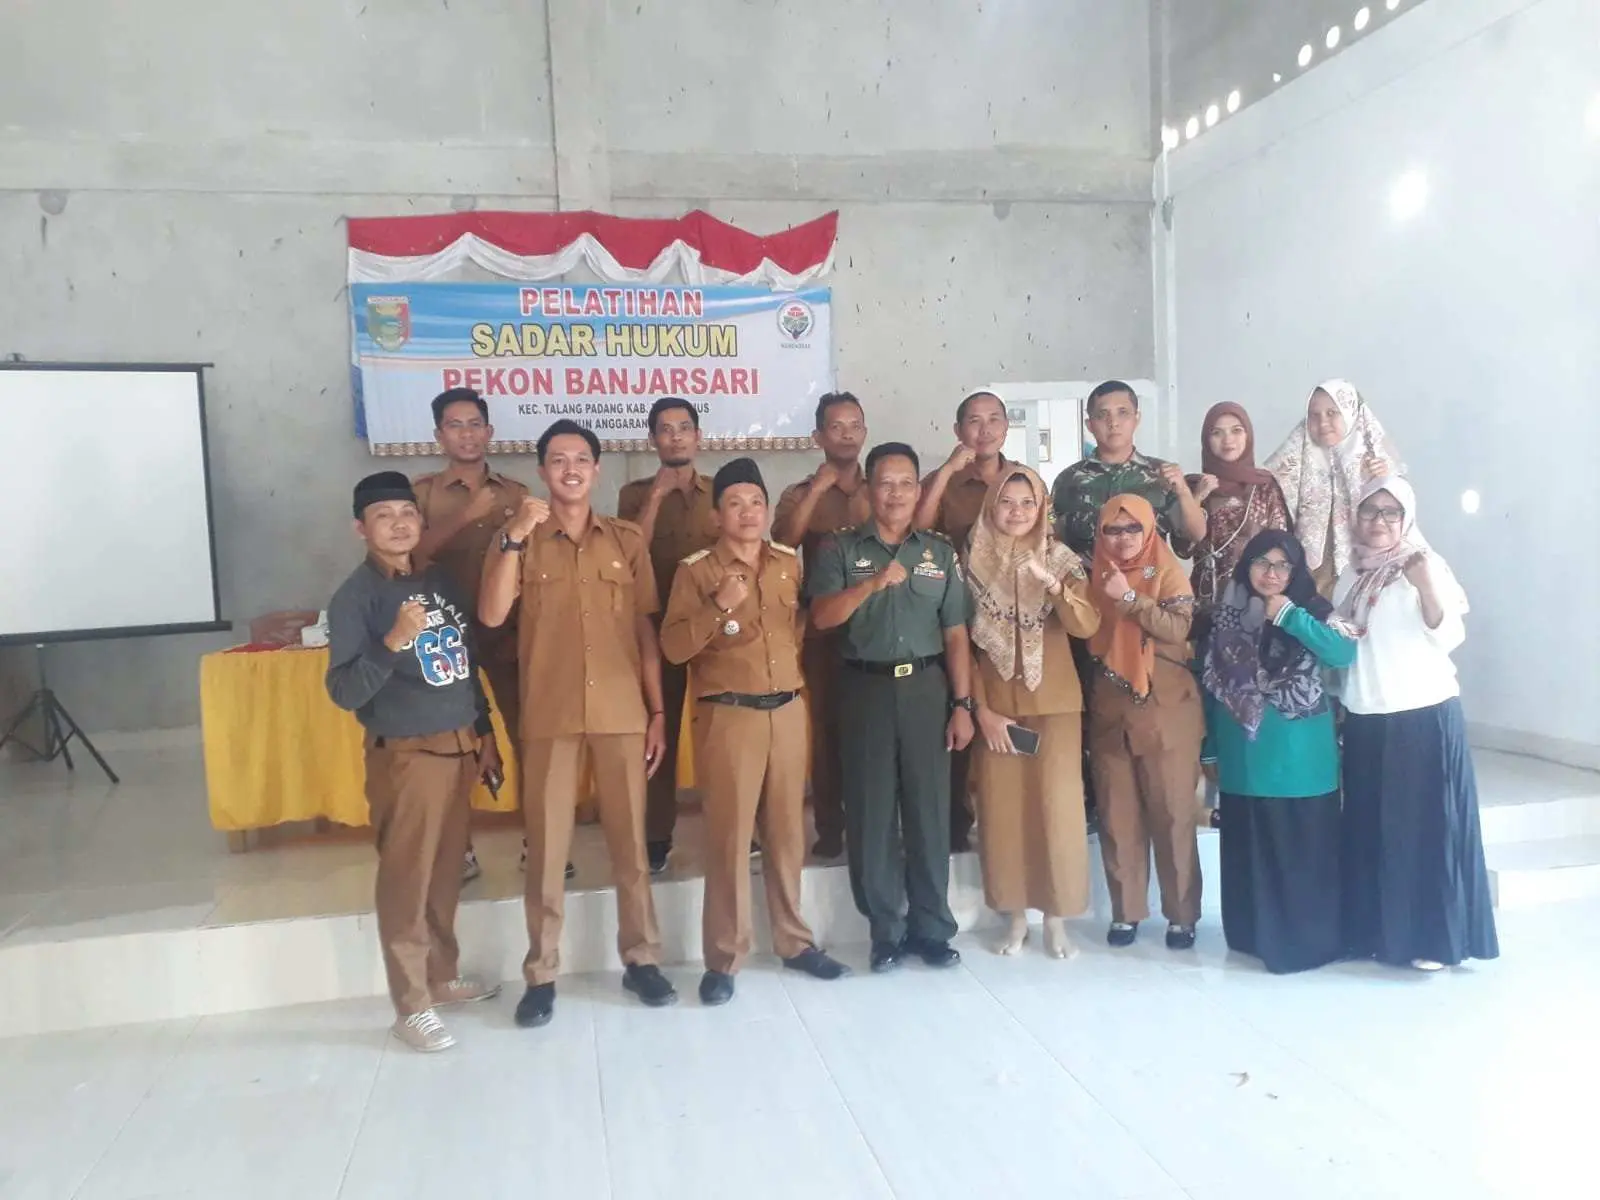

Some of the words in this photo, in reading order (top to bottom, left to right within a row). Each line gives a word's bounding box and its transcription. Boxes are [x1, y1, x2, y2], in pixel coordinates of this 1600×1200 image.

[520, 287, 704, 317] PELATIHAN
[471, 323, 597, 357] SADAR
[605, 323, 738, 357] HUKUM
[442, 367, 553, 395] PEKON
[564, 367, 760, 395] BANJARSARI
[518, 403, 542, 415] KEC.
[544, 403, 582, 415] TALANG
[585, 403, 623, 414] PADANG
[626, 402, 649, 414] KAB.
[595, 418, 649, 429] ANGGARAN
[433, 592, 467, 634] WALL
[414, 624, 470, 687] 66
